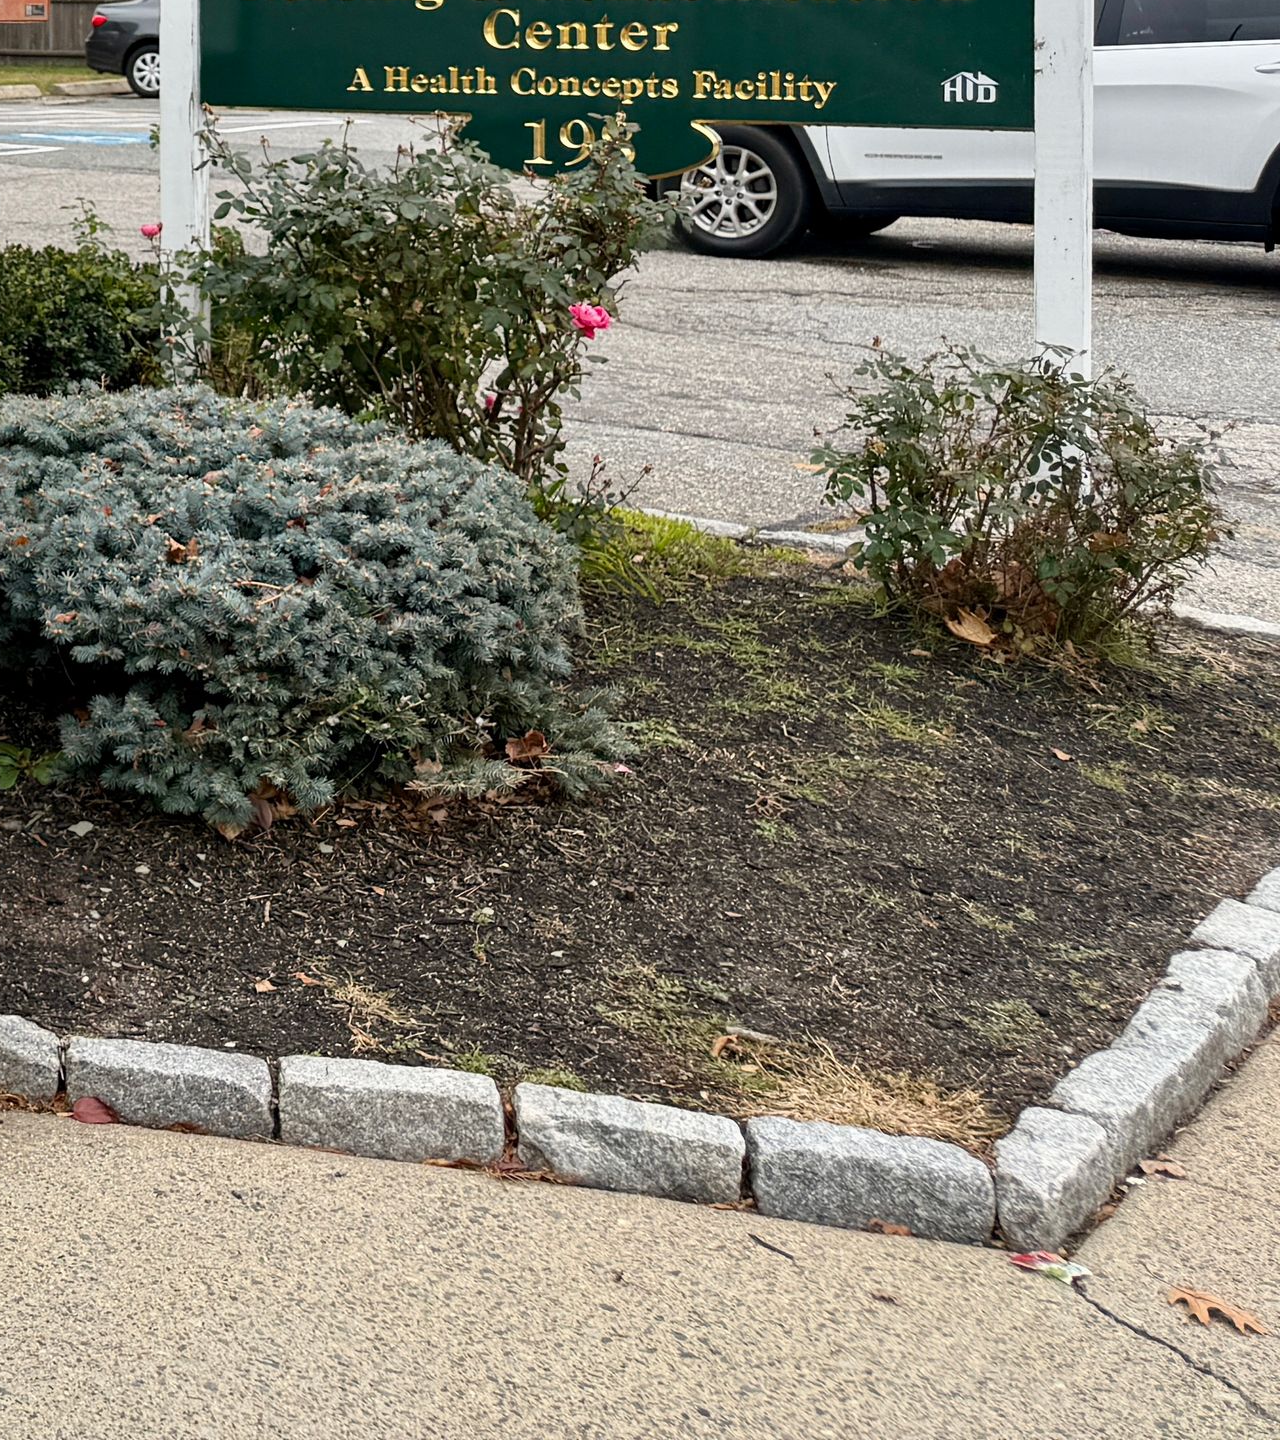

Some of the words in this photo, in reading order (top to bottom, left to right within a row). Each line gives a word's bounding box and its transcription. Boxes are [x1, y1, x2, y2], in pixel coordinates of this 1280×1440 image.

[482, 7, 680, 52] Center
[346, 66, 375, 93] A
[383, 65, 498, 96] Health
[510, 67, 679, 105] Concepts
[692, 69, 837, 110] Facility
